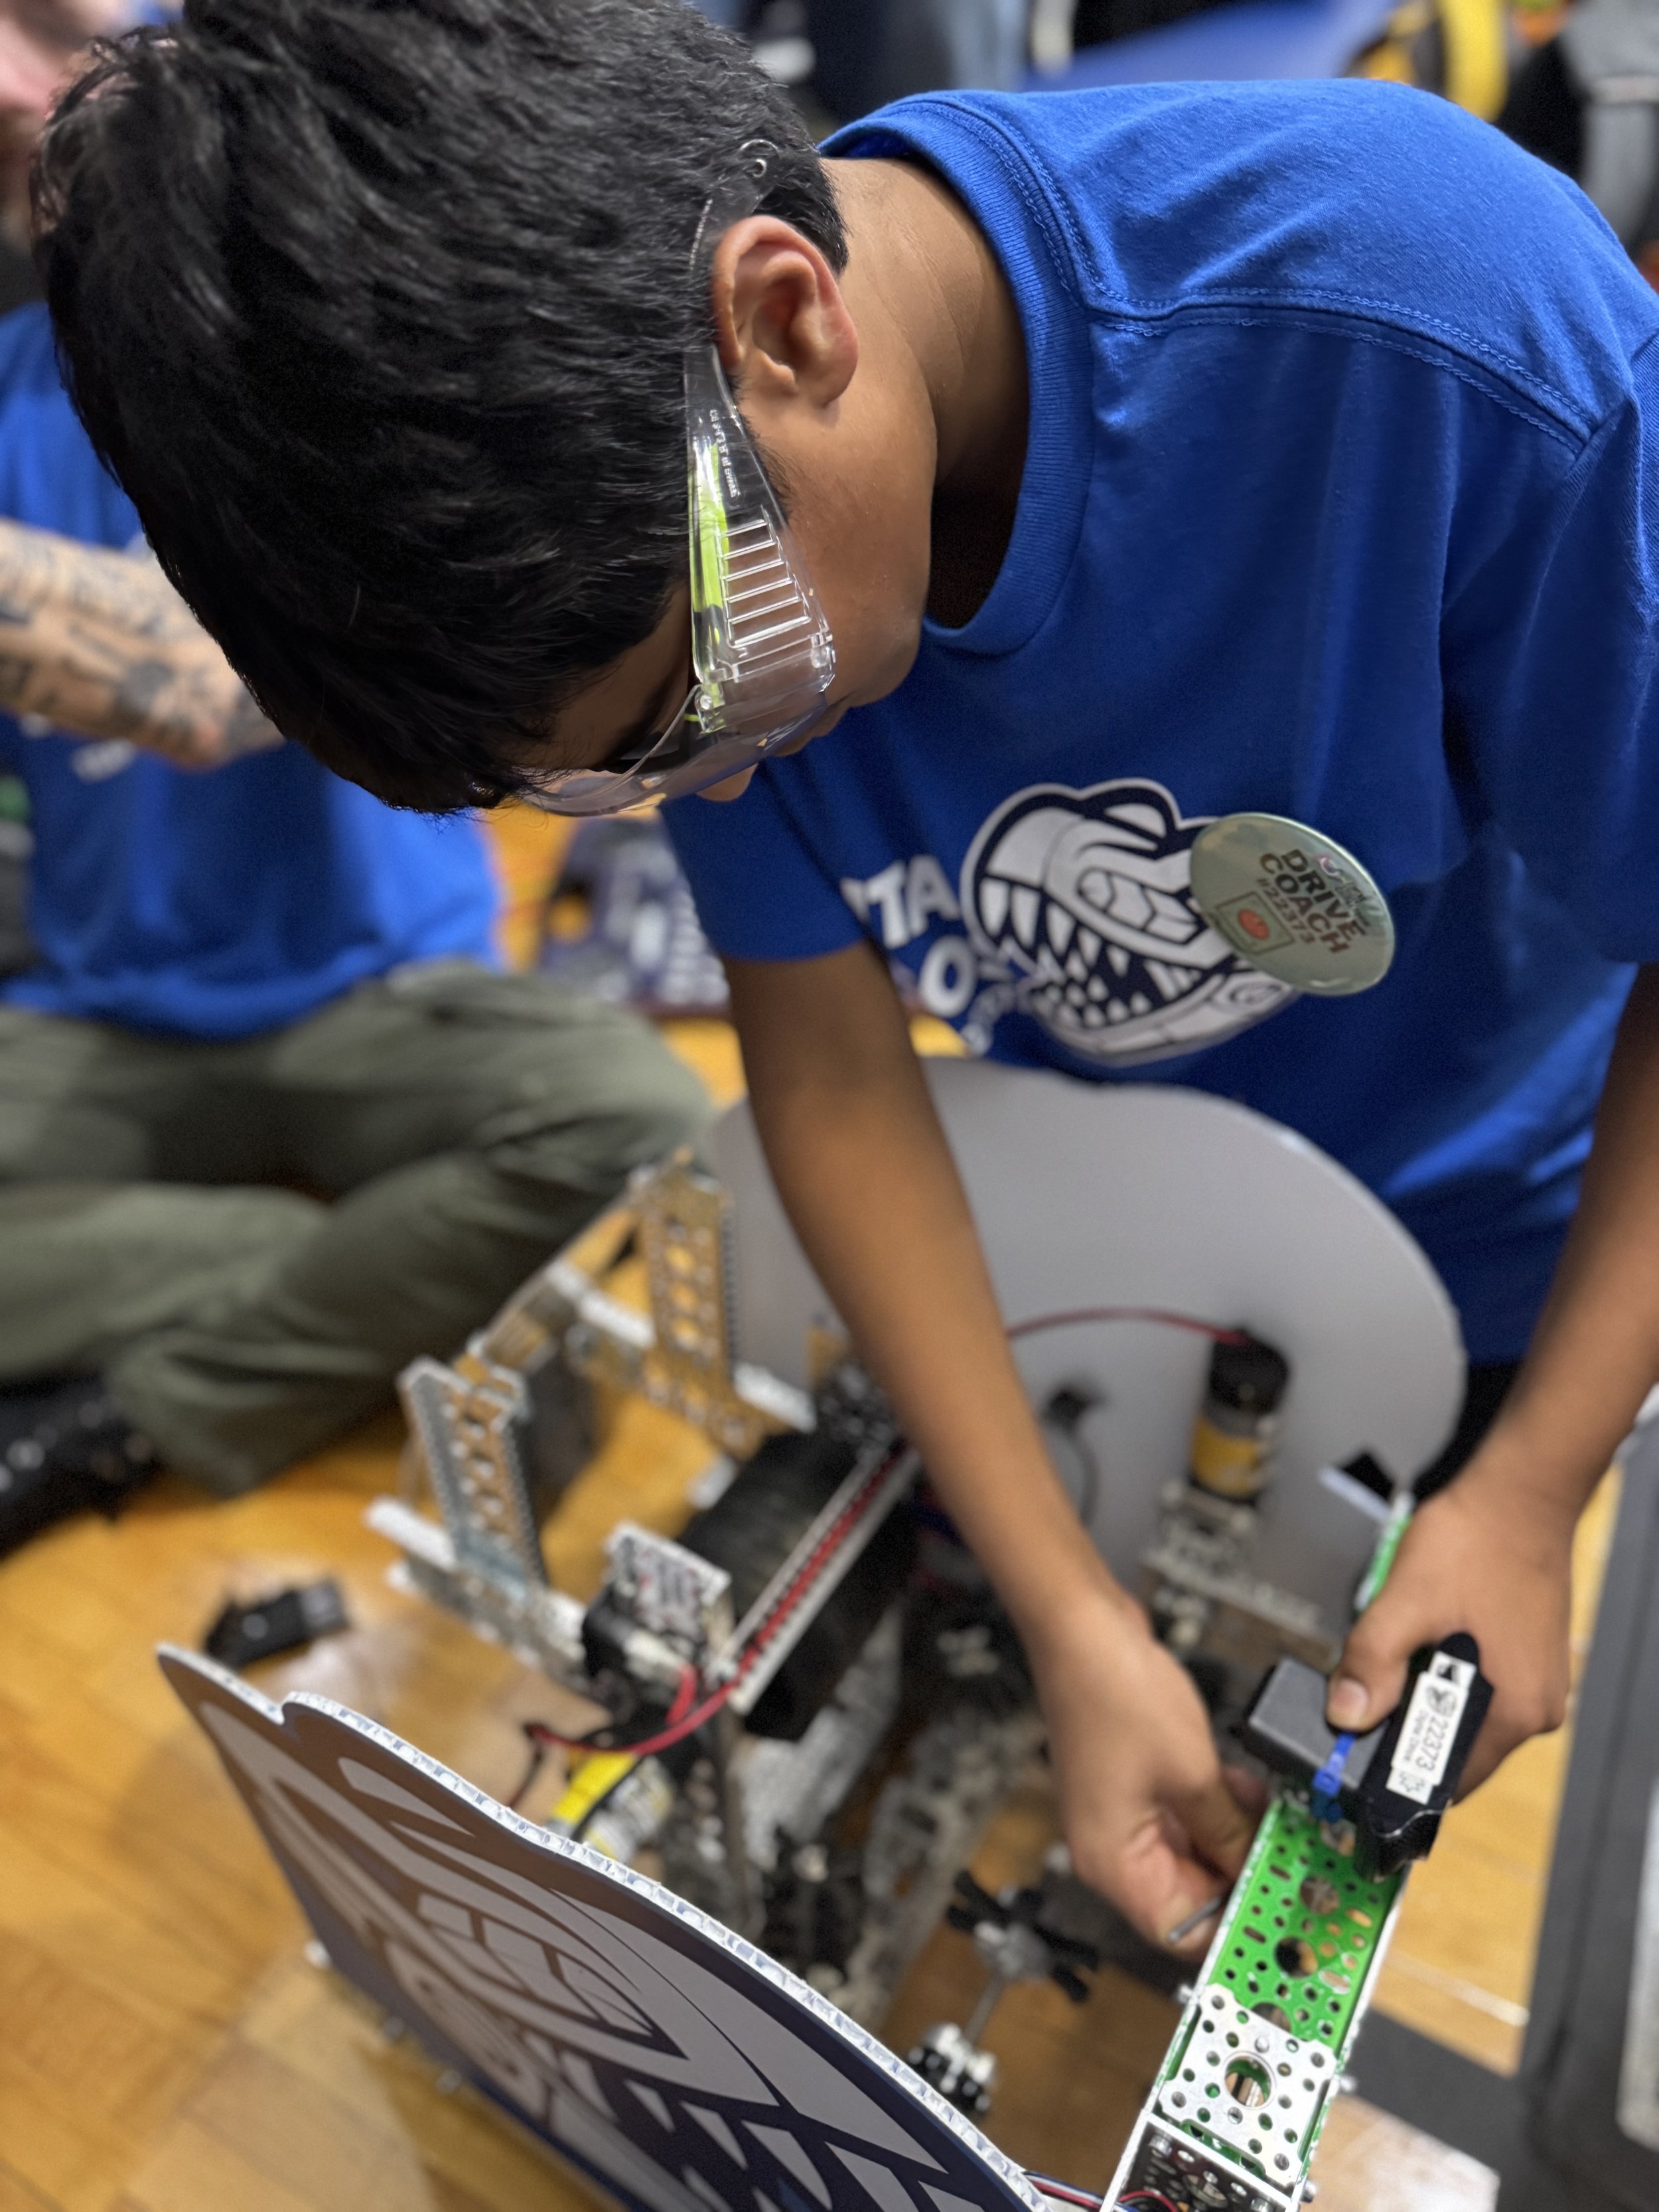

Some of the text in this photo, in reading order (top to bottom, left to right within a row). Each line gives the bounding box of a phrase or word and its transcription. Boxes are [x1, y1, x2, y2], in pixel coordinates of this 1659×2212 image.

[839, 855, 962, 949] TA
[1260, 853, 1350, 954] COACH
[1281, 849, 1366, 941] DRIVE
[1415, 1716, 1449, 1771] 22373
